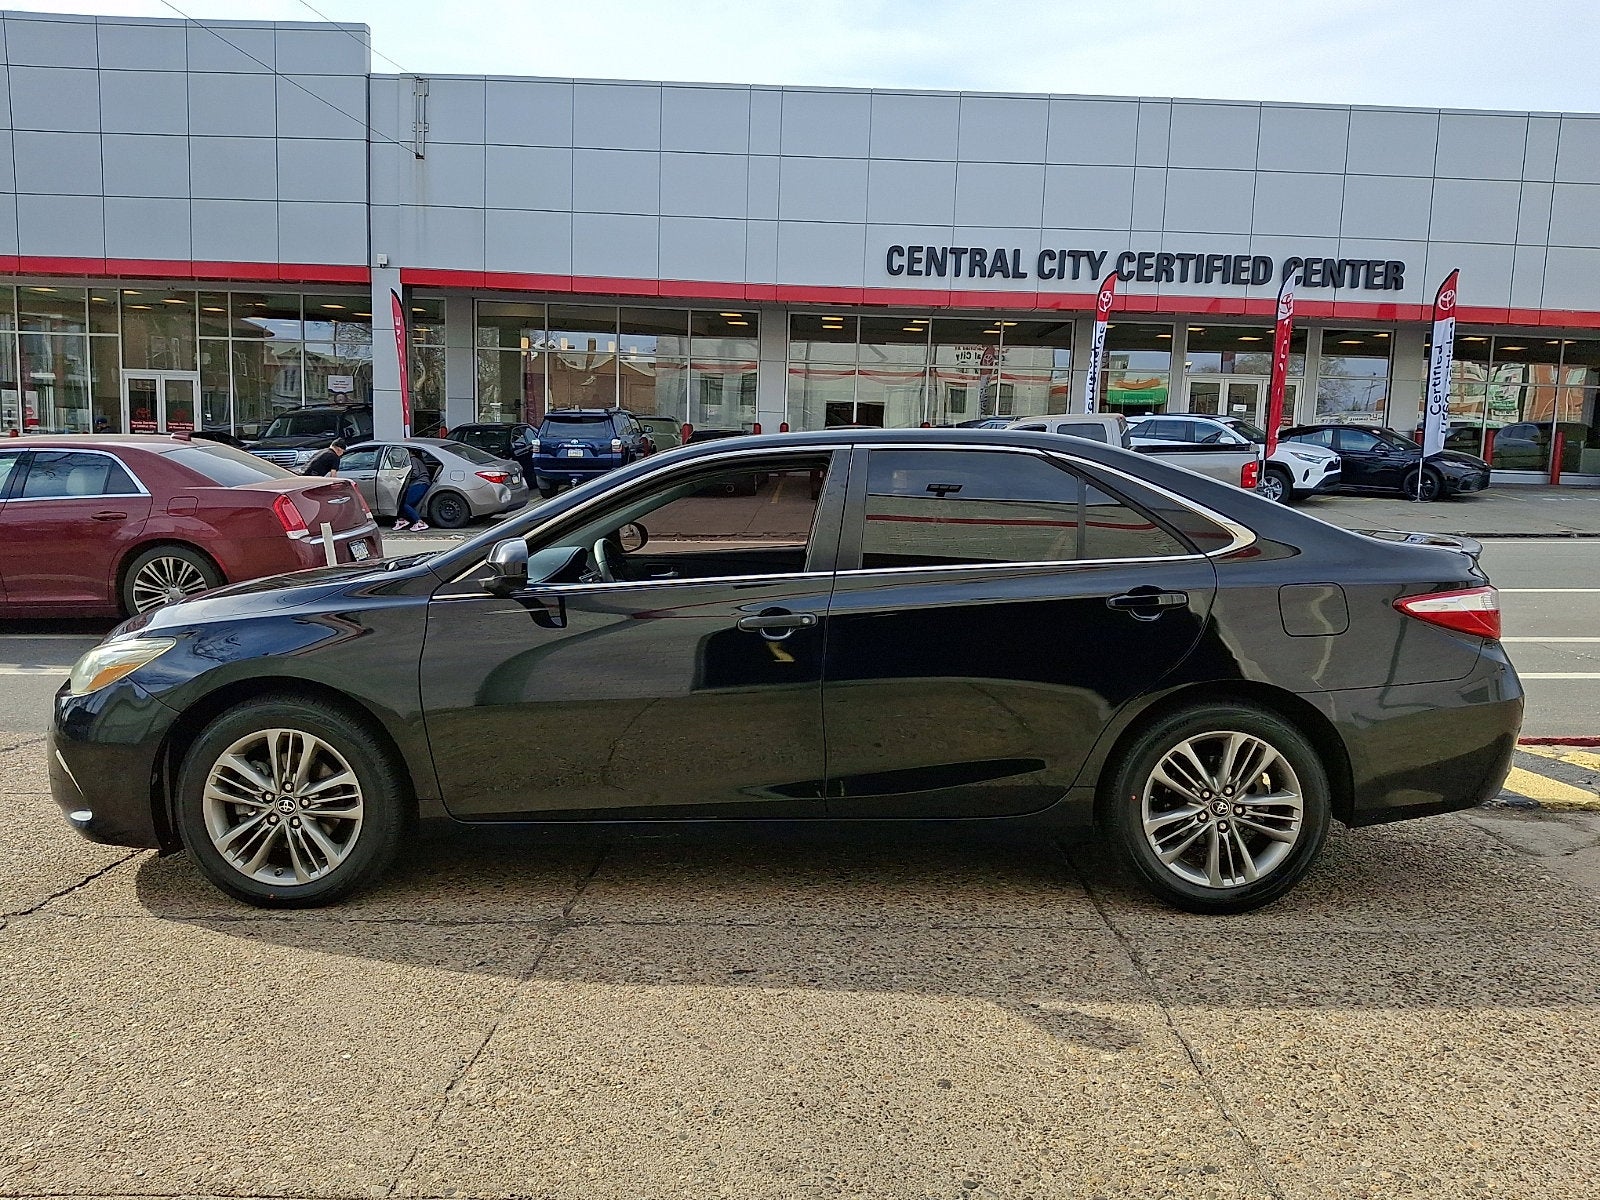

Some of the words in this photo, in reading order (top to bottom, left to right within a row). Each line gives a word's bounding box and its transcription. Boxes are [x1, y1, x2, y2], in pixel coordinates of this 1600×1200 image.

[887, 245, 1027, 279] CENTRAL
[1037, 250, 1108, 280] CITY
[1116, 251, 1273, 285] CERTIFIED
[1283, 257, 1405, 290] CENTER
[1430, 344, 1443, 415] Certified
